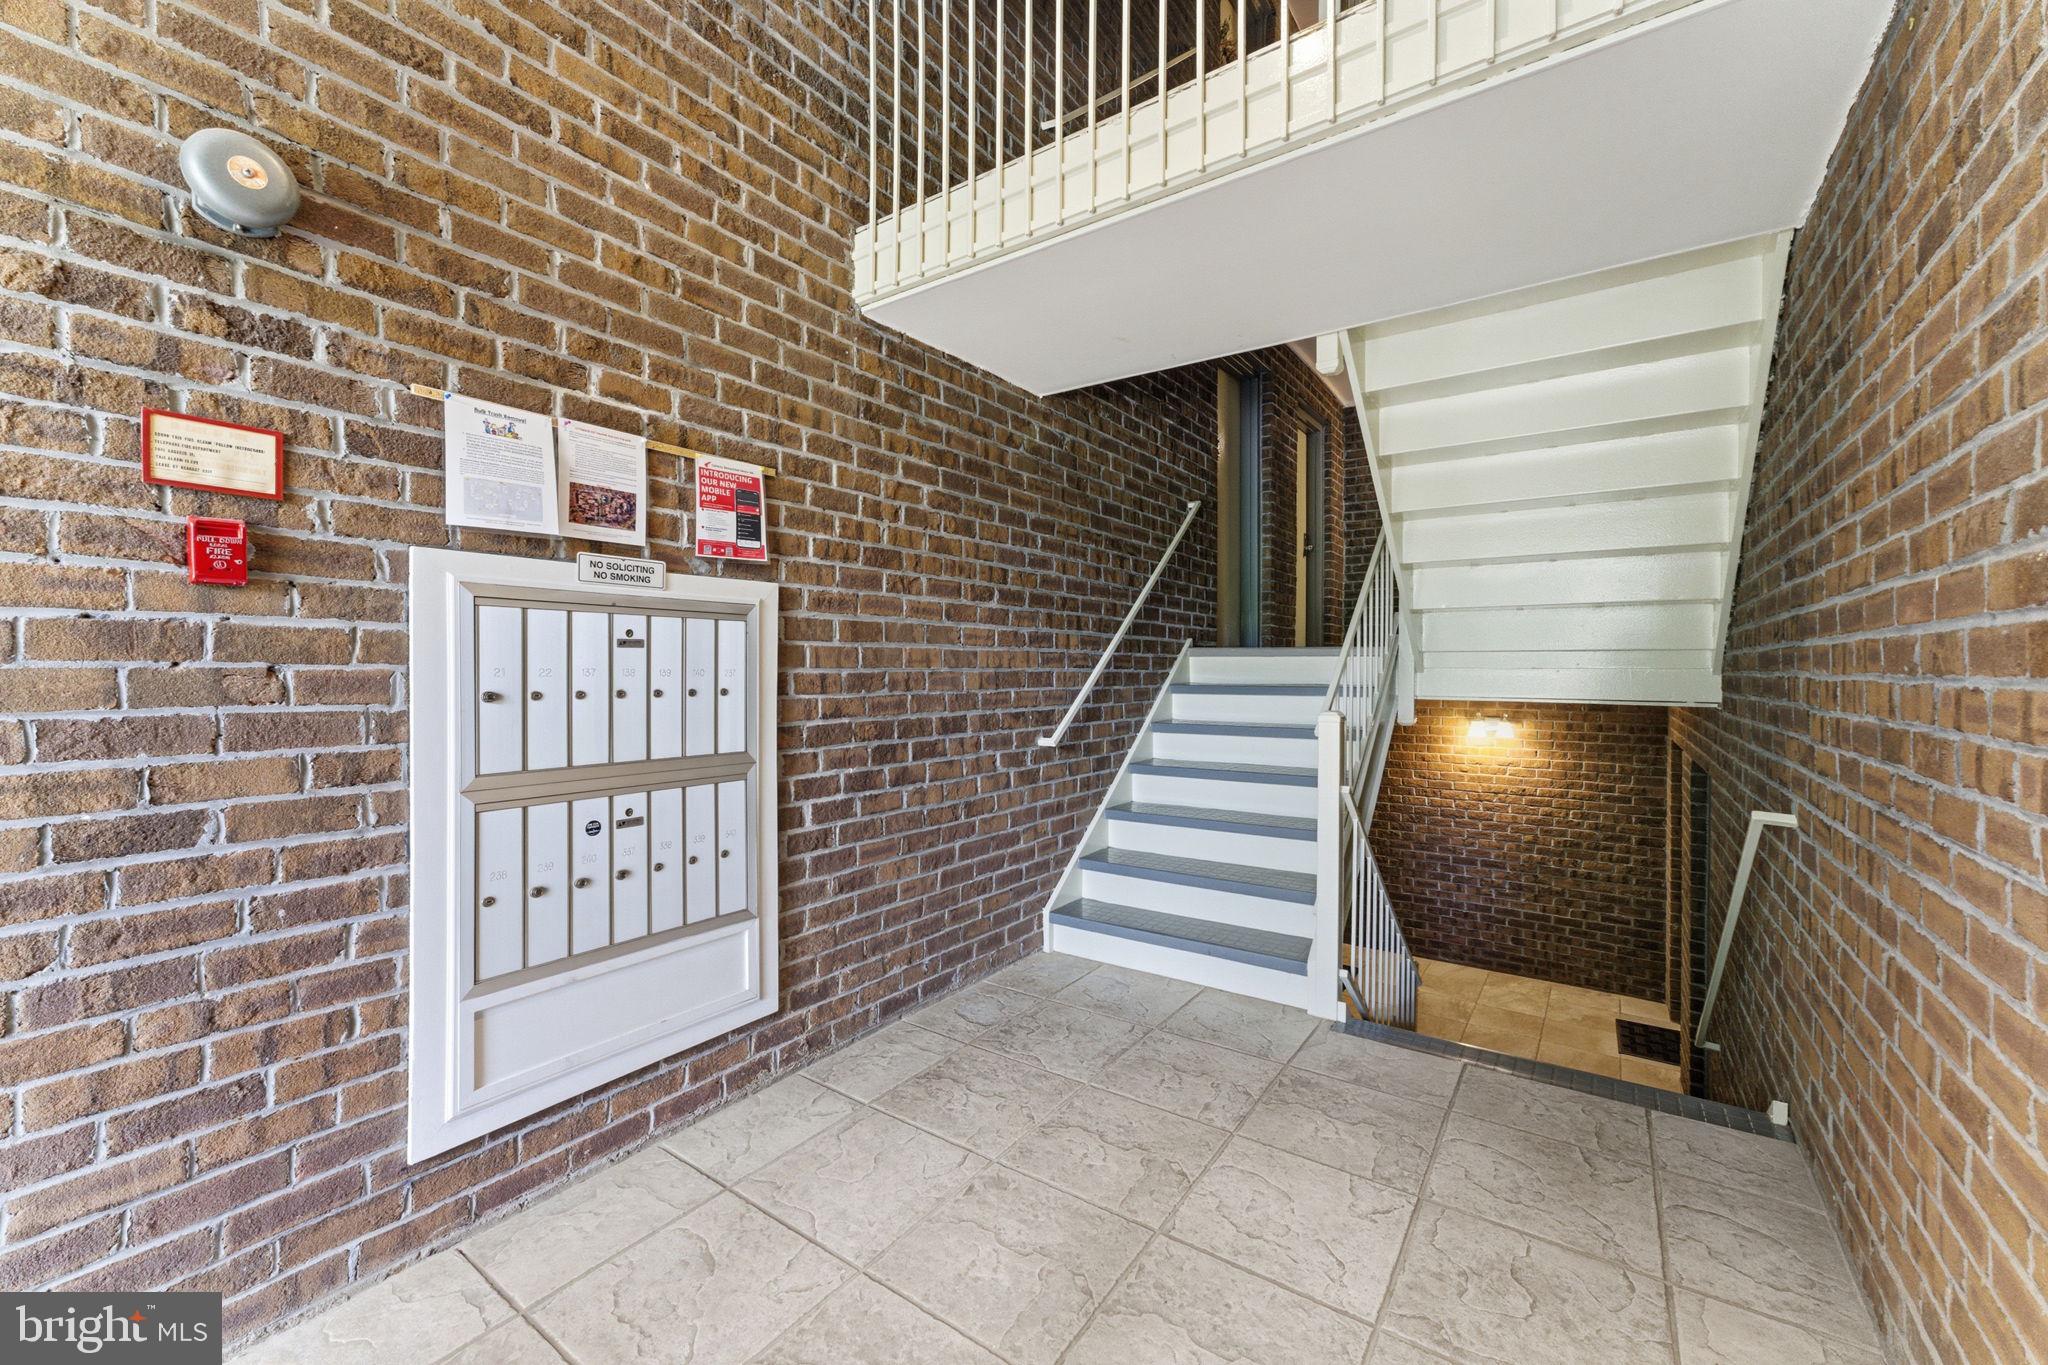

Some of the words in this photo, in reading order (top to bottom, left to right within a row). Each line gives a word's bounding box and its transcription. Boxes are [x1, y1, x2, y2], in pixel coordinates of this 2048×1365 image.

[700, 468, 753, 484] INTRODUCING
[701, 477, 718, 486] OUR
[719, 480, 737, 489] NEW
[701, 485, 731, 497] MOBILE
[701, 494, 717, 502] APP
[206, 547, 233, 556] FIRE
[589, 560, 604, 569] NO
[605, 562, 655, 575] SOLICITING
[593, 571, 608, 580] NO
[609, 572, 651, 584] SMOKING
[494, 667, 506, 677] 21
[538, 667, 553, 678] 22
[582, 667, 597, 678] 137
